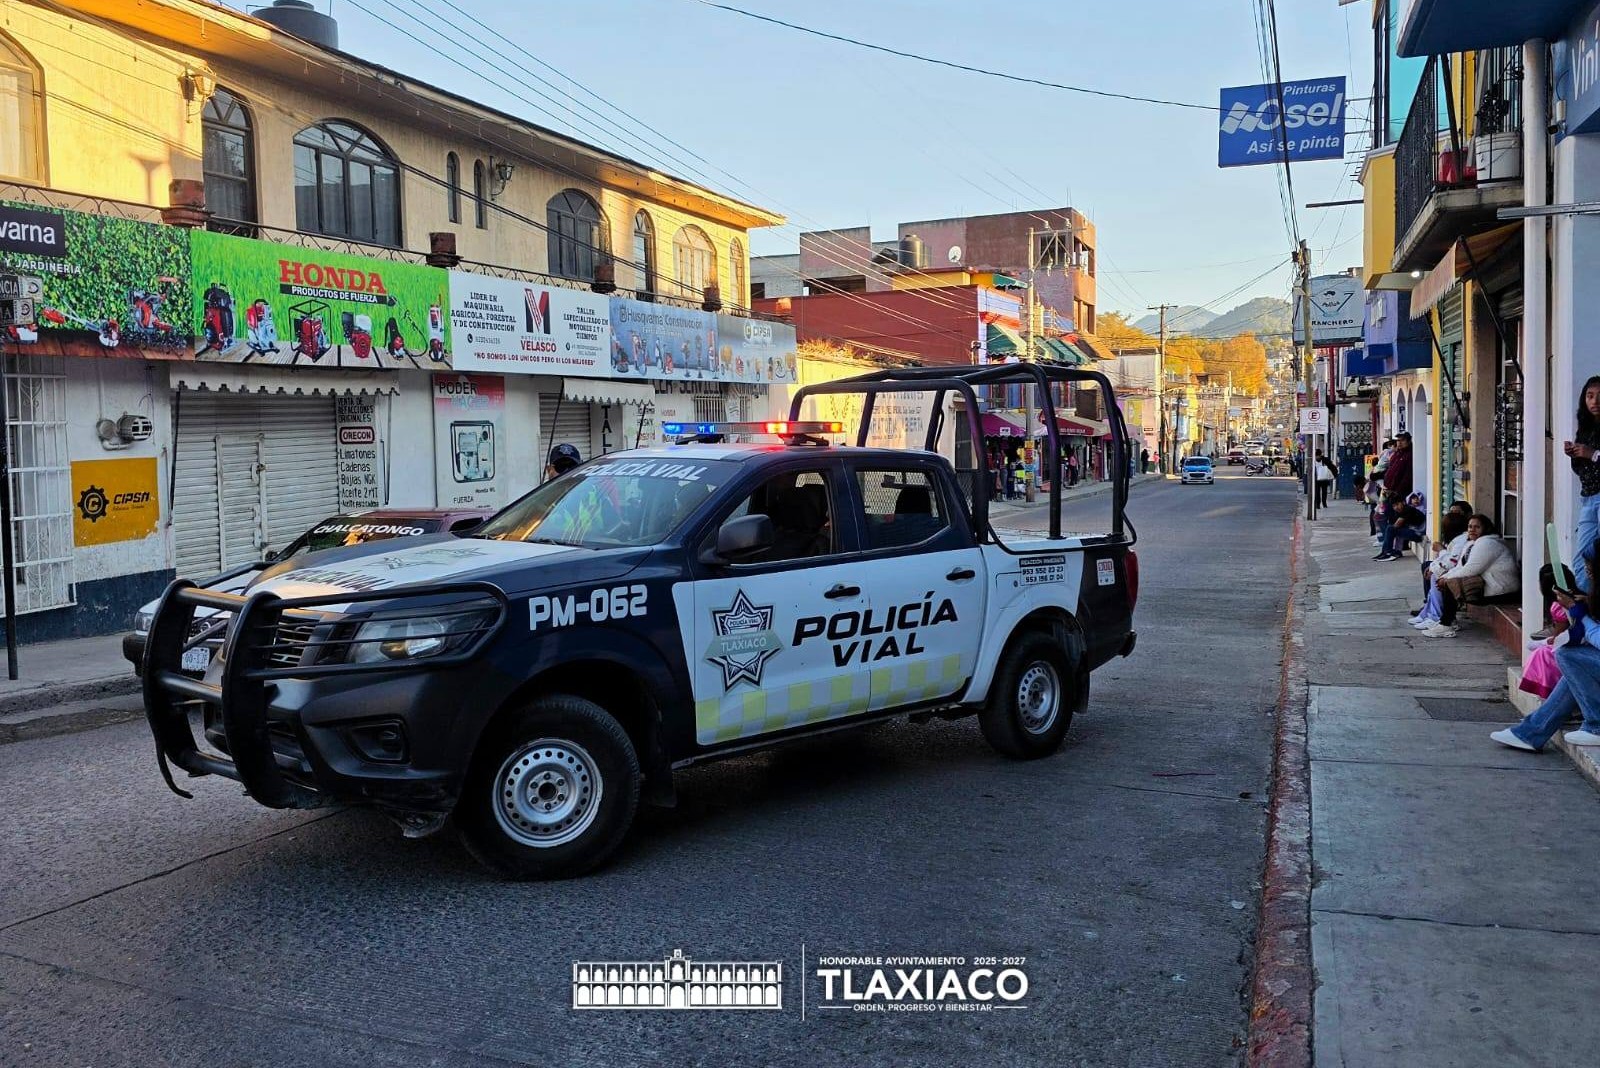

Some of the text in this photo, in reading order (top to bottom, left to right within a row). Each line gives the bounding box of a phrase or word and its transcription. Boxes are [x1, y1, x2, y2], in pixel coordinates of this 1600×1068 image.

[1283, 83, 1336, 97] Pinturas
[1255, 92, 1344, 131] Osel
[1246, 135, 1340, 155] Así se pinta
[15, 259, 82, 275] JARDINERIA
[279, 260, 387, 294] HONDA
[291, 286, 379, 303] PRODUCTOS DE FUERZA
[470, 292, 498, 303] LIDER EN
[464, 301, 504, 313] MAQUINARIA
[577, 307, 595, 315] TALLER
[486, 313, 517, 323] FORESTAL
[564, 313, 601, 325] ESPECIALIZADO
[1311, 319, 1354, 327] RANCHERO
[453, 319, 515, 332] Y DE CONSTRUCCION
[576, 332, 598, 341] TIEMPOS
[520, 340, 557, 353] VELASCO
[487, 353, 507, 361] SOMOS
[438, 381, 478, 396] PODER
[1311, 411, 1318, 419] E
[1398, 405, 1406, 432] PIN
[343, 431, 371, 441] OREGON
[340, 461, 371, 473] Cadenas
[650, 464, 708, 481] VIAL
[453, 495, 474, 504] FUERZA
[313, 524, 425, 537] CHALCATONGO
[529, 584, 648, 631] PM-062
[792, 591, 958, 647] POLICÍA
[720, 637, 767, 653] TLAXIACO
[832, 632, 925, 668] VIAL
